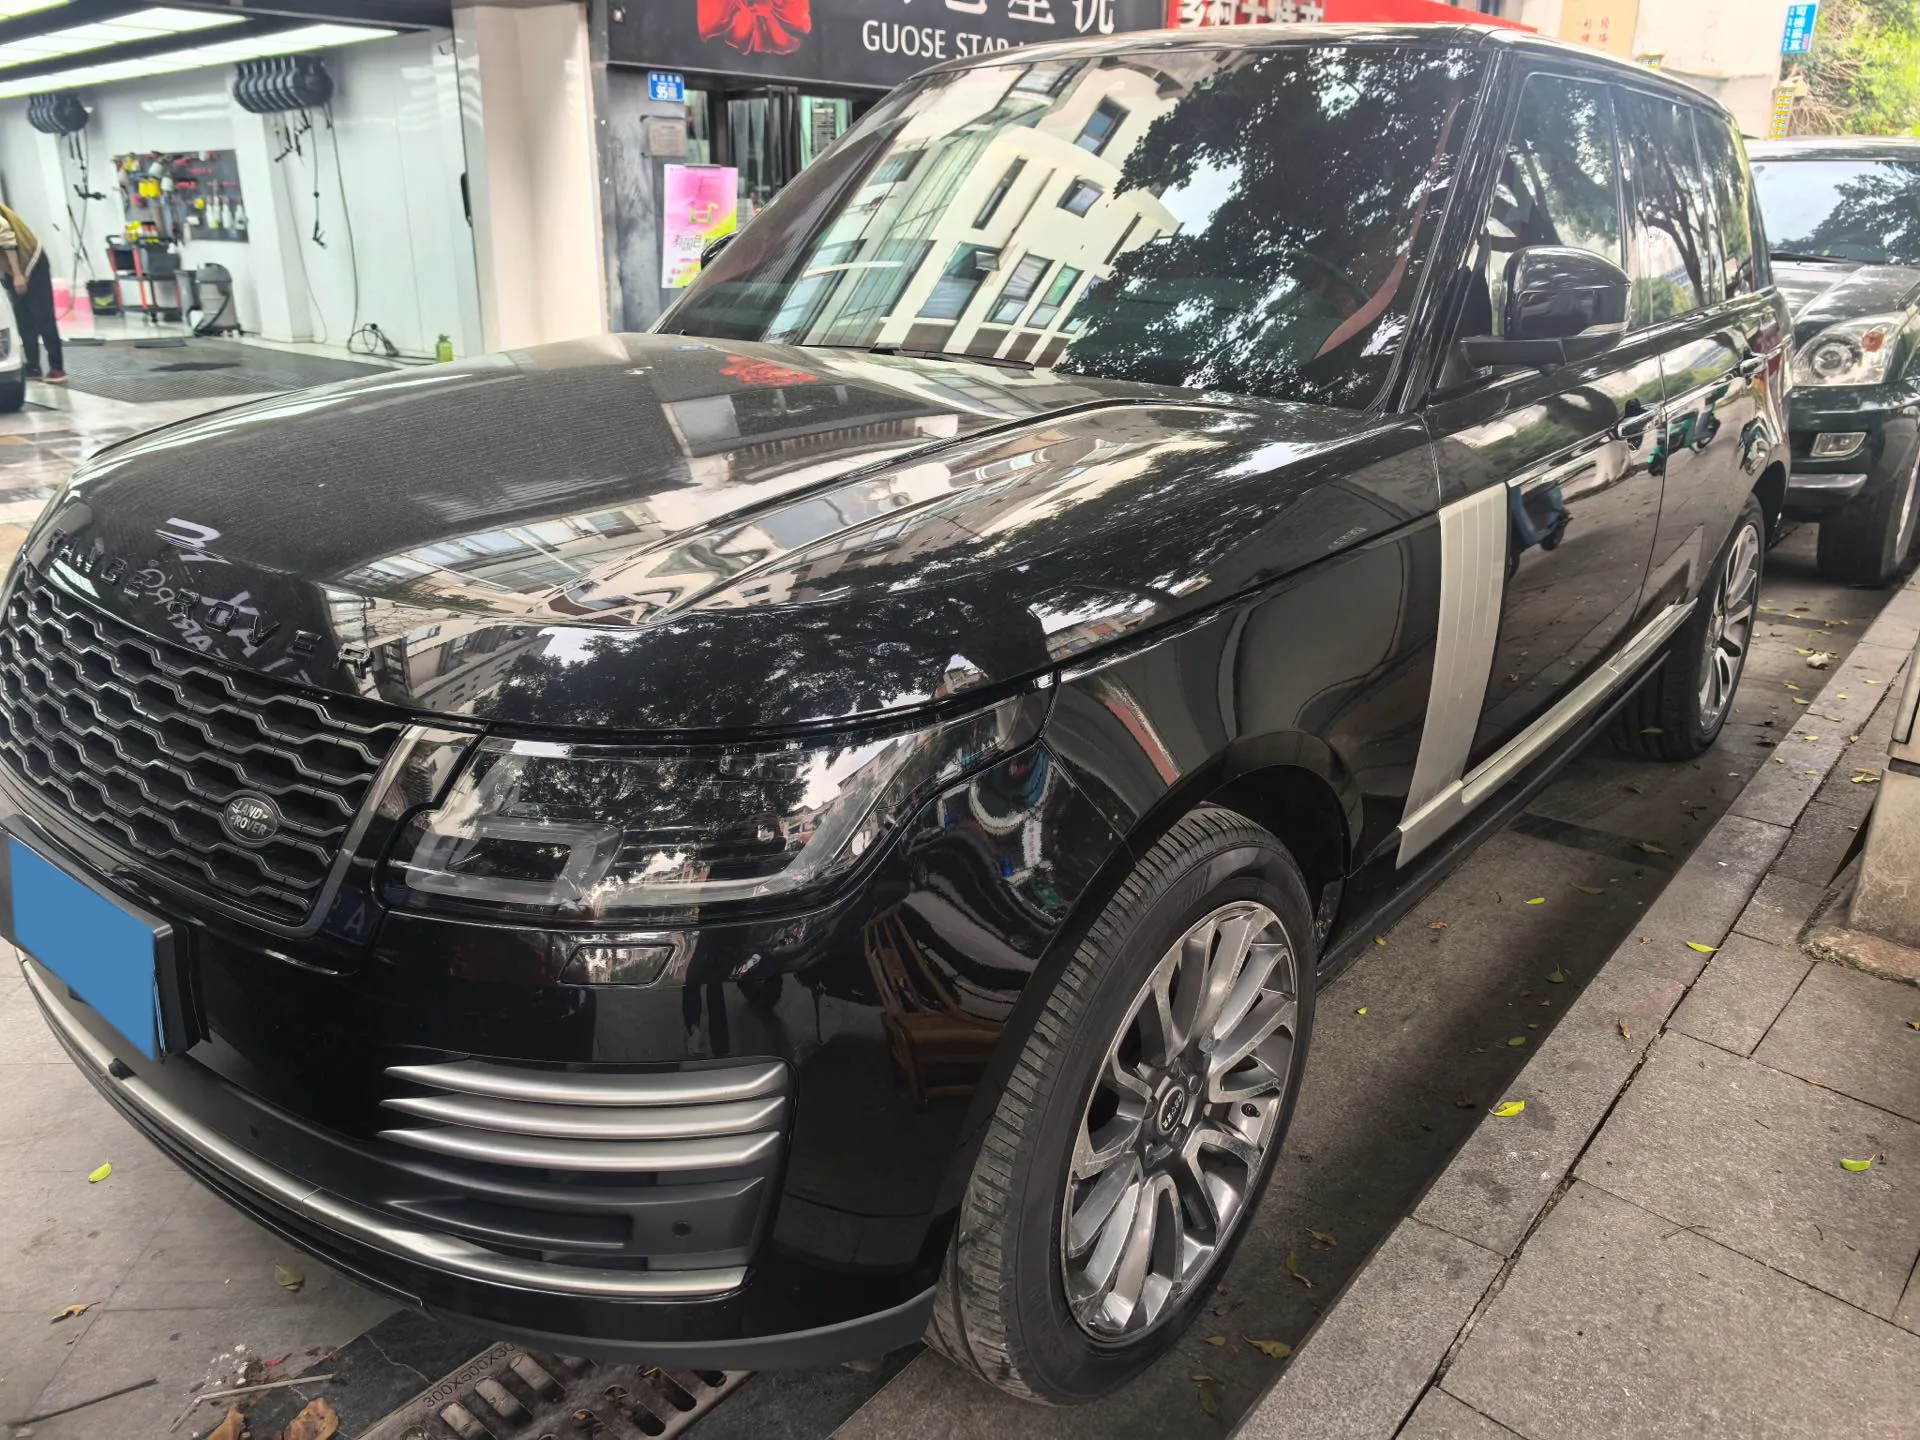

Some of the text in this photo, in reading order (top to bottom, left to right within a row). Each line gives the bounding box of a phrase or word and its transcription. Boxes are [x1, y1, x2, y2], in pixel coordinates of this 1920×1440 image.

[862, 20, 946, 59] GUOSE
[167, 588, 372, 679] ROVER
[231, 801, 263, 819] LAND
[233, 815, 267, 836] ROVER
